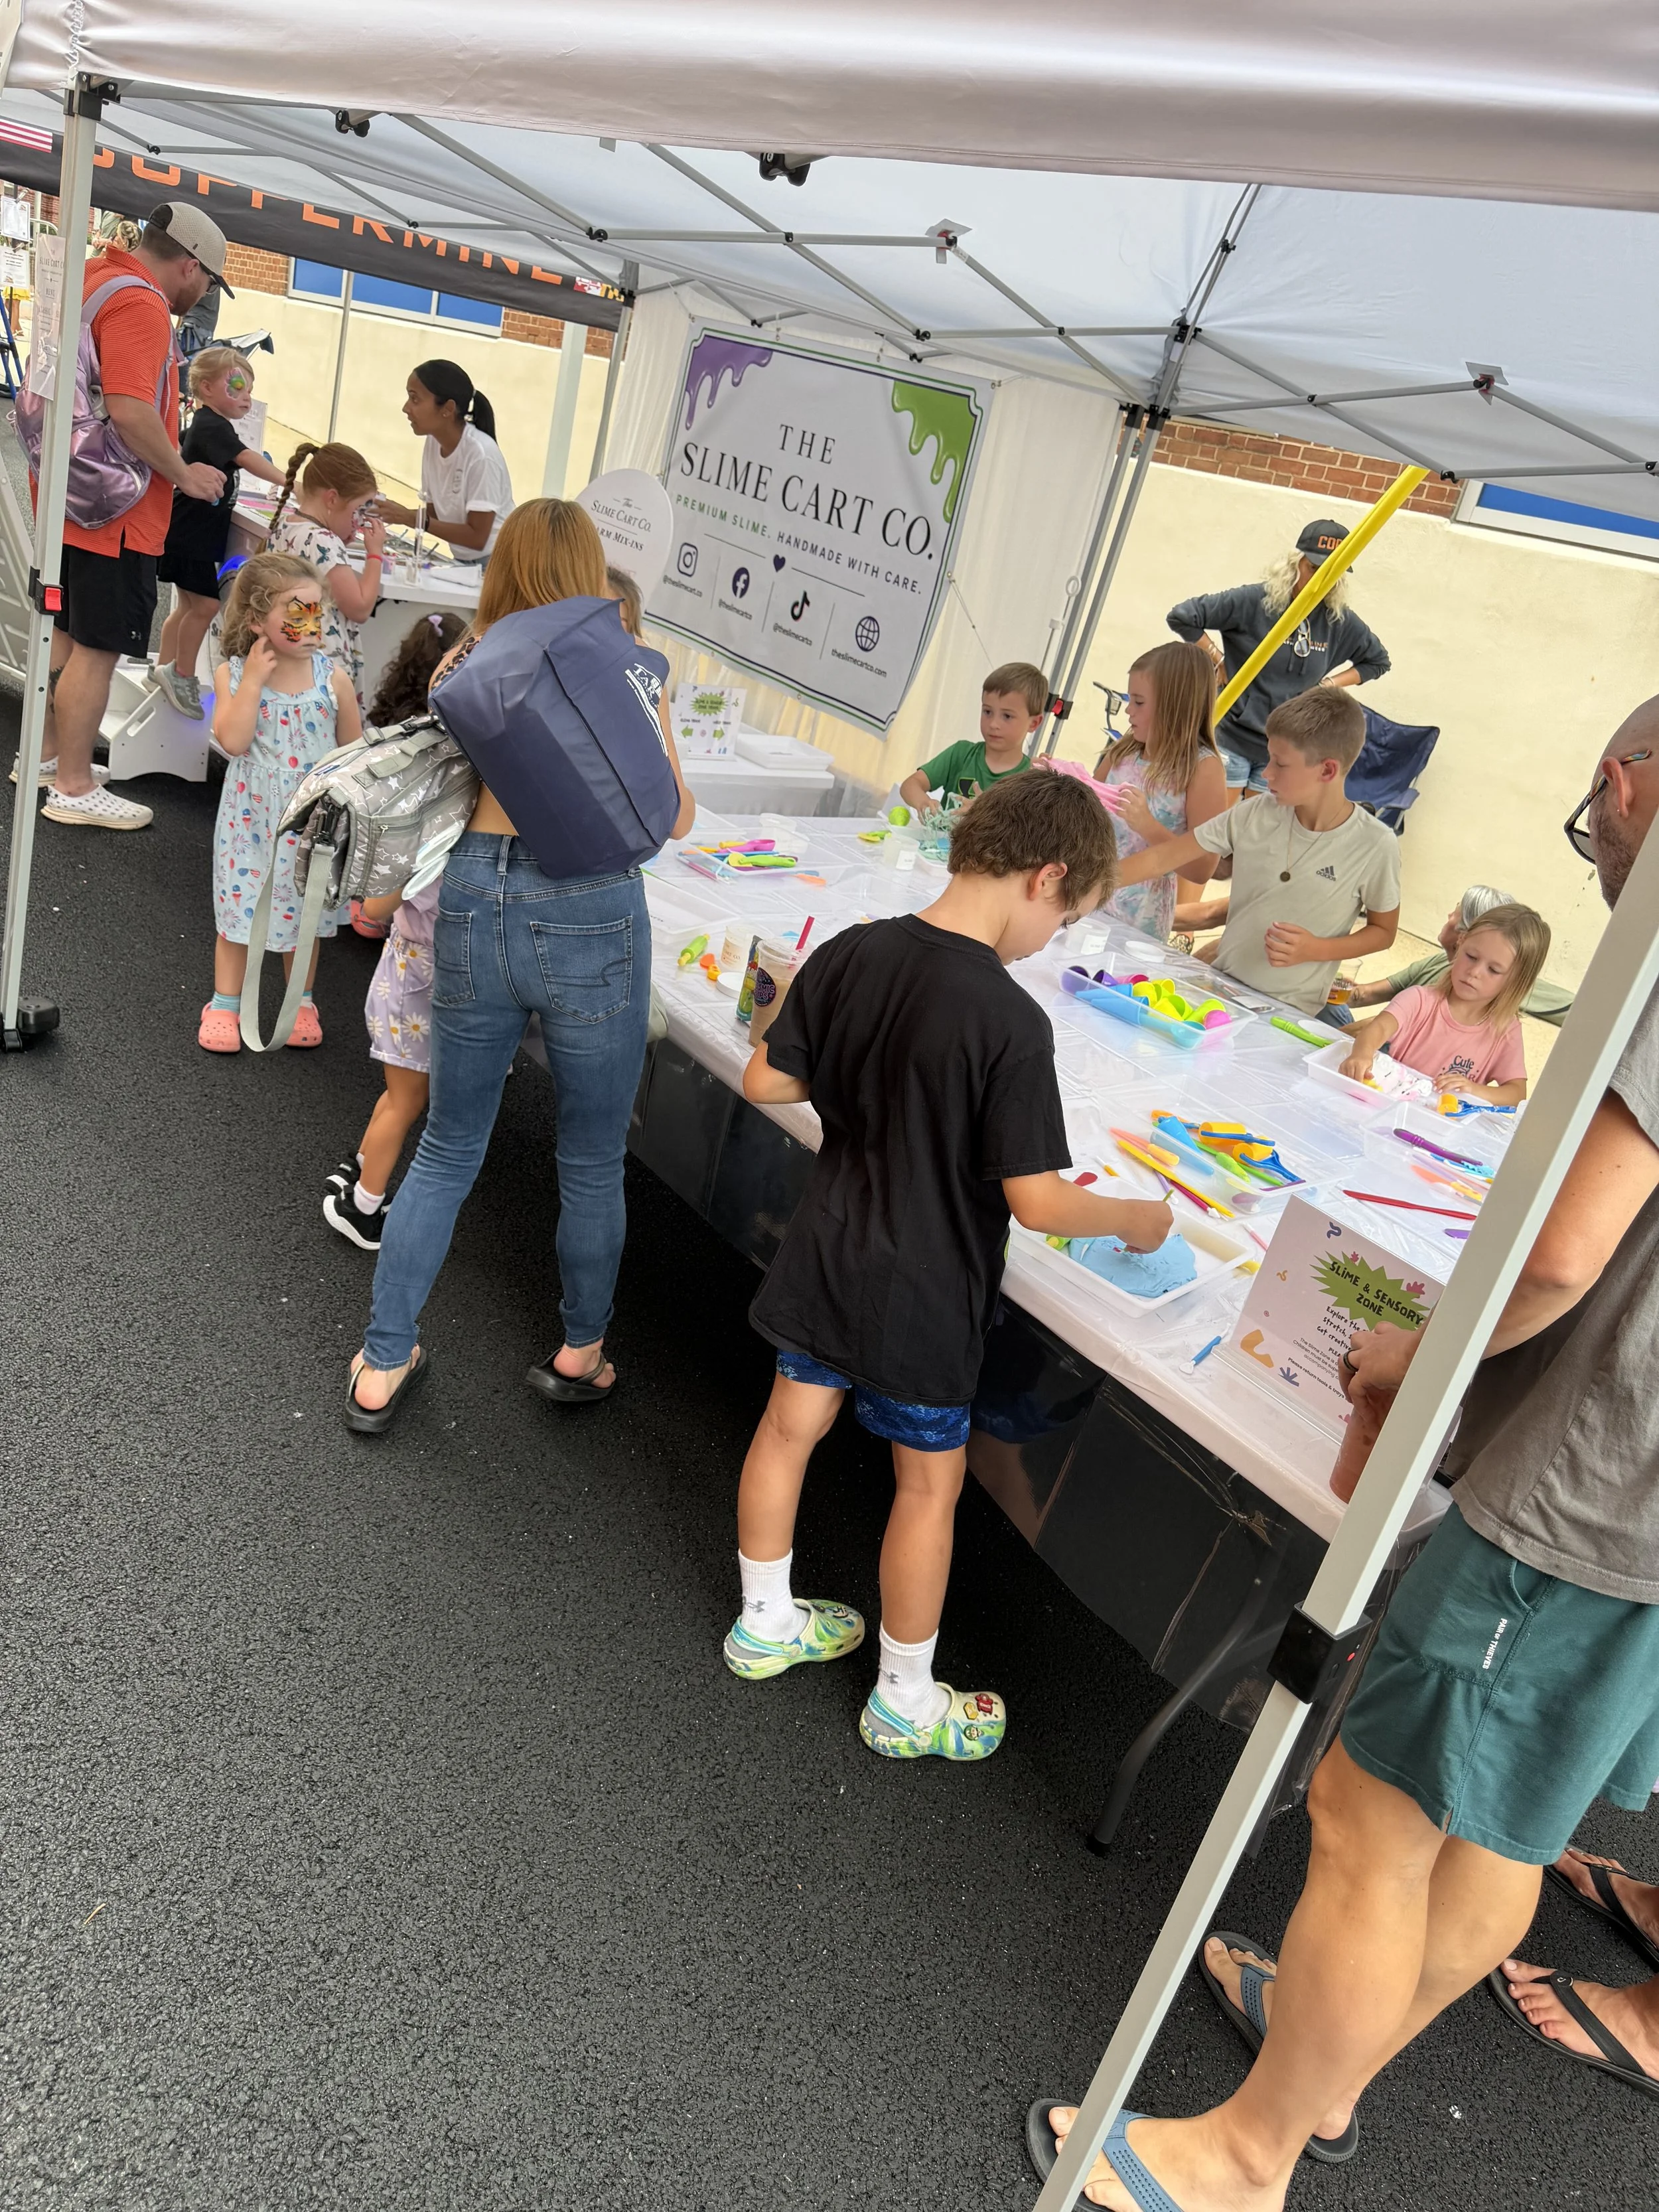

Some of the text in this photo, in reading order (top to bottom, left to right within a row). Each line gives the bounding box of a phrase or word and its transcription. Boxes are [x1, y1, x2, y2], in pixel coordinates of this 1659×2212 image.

[779, 423, 835, 465] THE
[681, 442, 933, 560] SLIME CART CO.
[676, 494, 921, 595] PREMIUM SLIME. HANDMADE WITH CARE.
[831, 648, 887, 678] theslimecartco.com
[1316, 870, 1336, 882] adidas
[1453, 1055, 1475, 1069] Cute
[1356, 1293, 1384, 1317] ZONE
[1363, 1283, 1370, 1294] &
[1374, 1289, 1424, 1325] SENSORY
[1326, 1306, 1360, 1331] Explore the
[1317, 1326, 1328, 1336] Get
[1293, 1339, 1311, 1354] Children
[1311, 1351, 1322, 1361] must
[1328, 1347, 1340, 1357] PLEA
[1287, 1357, 1303, 1369] Please
[1302, 1367, 1317, 1379] return
[1317, 1377, 1328, 1387] tools
[1333, 1388, 1344, 1398] trays
[1303, 1354, 1335, 1378] accompanying
[1496, 1618, 1508, 1634] PAIR
[1482, 1640, 1498, 1670] THIEVES
